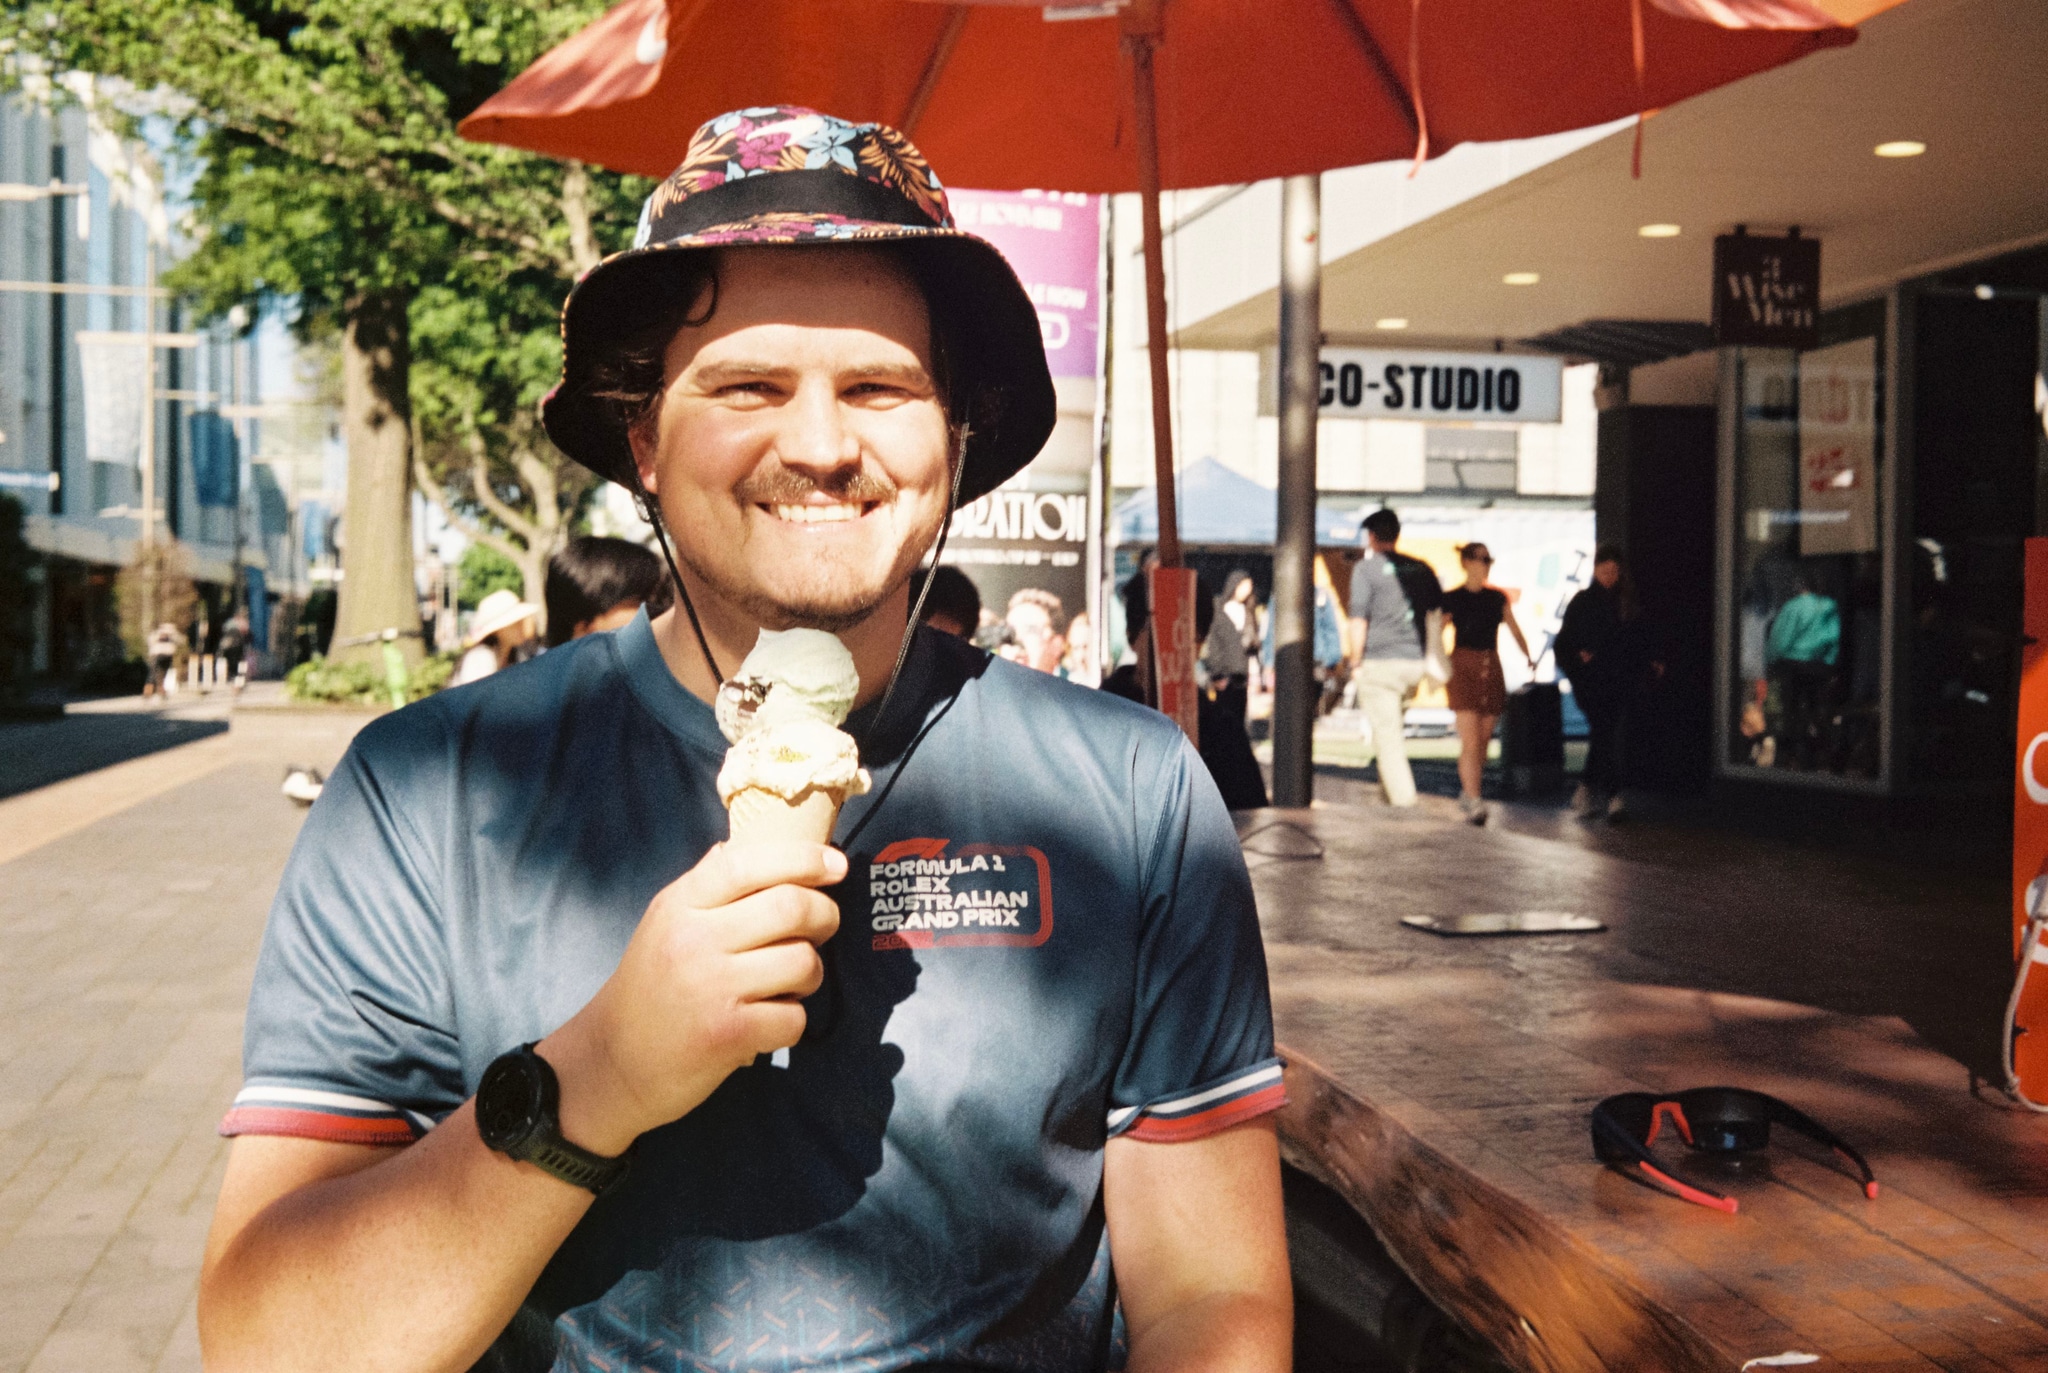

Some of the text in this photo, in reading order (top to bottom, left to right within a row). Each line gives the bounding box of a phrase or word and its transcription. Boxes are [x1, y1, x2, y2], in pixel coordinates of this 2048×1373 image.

[870, 855, 1006, 879] FORMULA 1
[870, 876, 950, 897] ROLEX
[871, 890, 1028, 914] AUSTRALIAN
[871, 908, 1020, 931] GRAND PRIX
